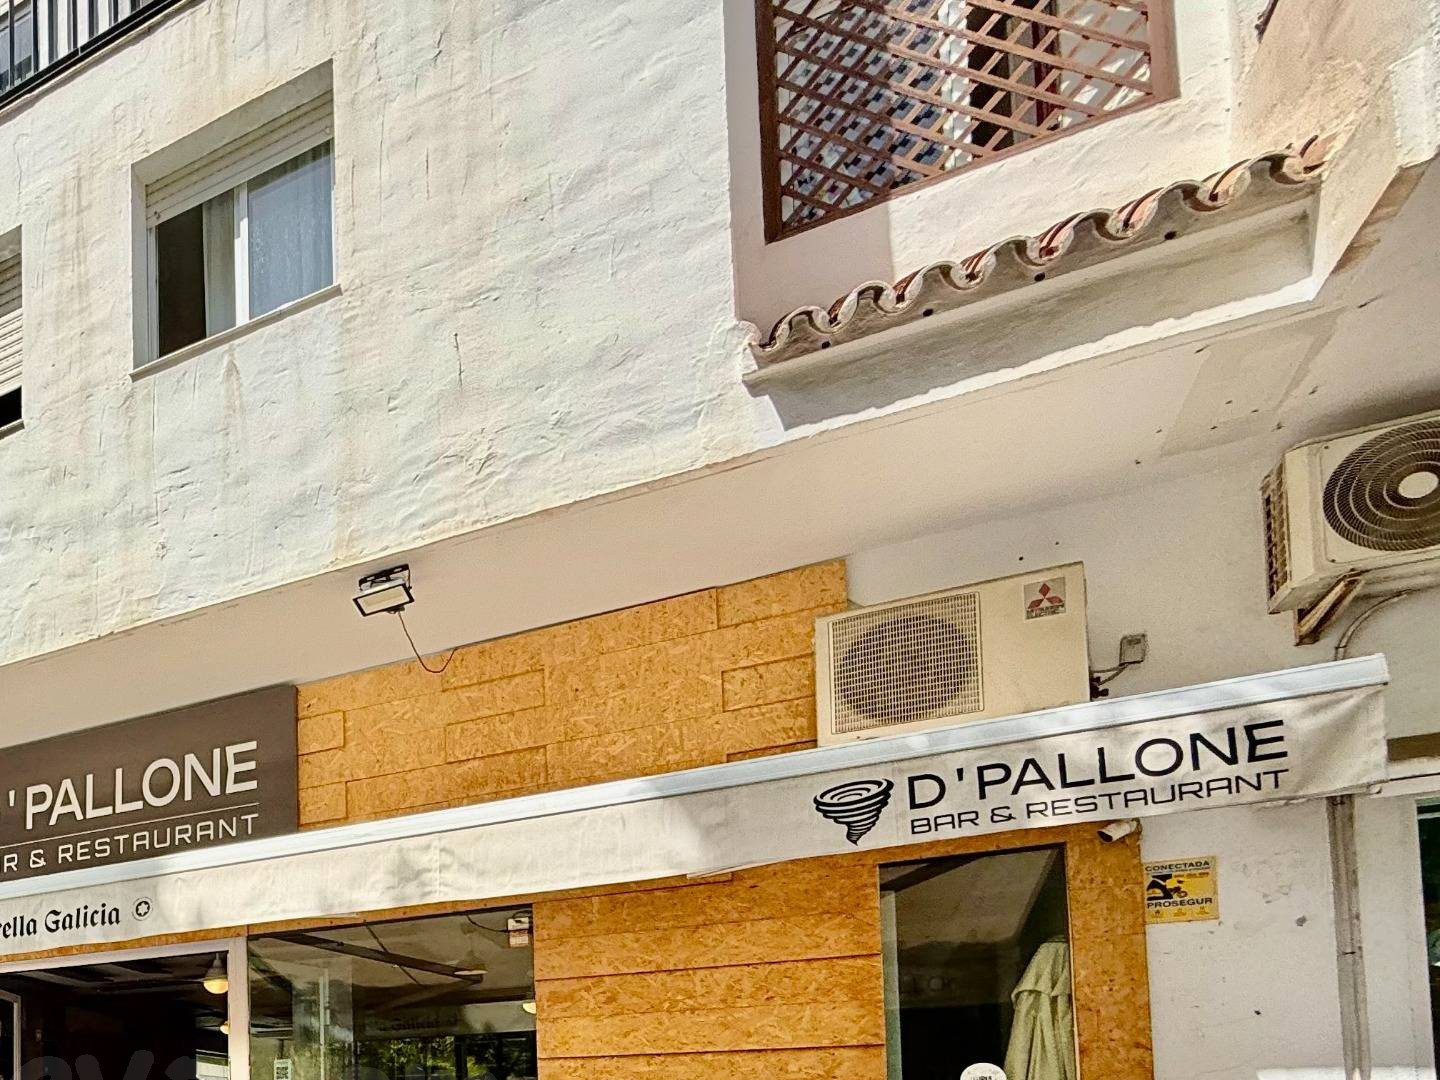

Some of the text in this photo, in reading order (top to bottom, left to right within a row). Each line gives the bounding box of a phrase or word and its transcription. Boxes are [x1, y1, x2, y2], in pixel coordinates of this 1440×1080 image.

[908, 720, 1289, 810] D'PALLONE
[910, 768, 1290, 835] BAR & RESTAURANT
[29, 849, 47, 869] &
[58, 813, 260, 864] RESTAURANT
[1144, 860, 1210, 872] CONECTADA
[44, 902, 121, 934] Galicia
[1146, 897, 1213, 909] PROSEGUR
